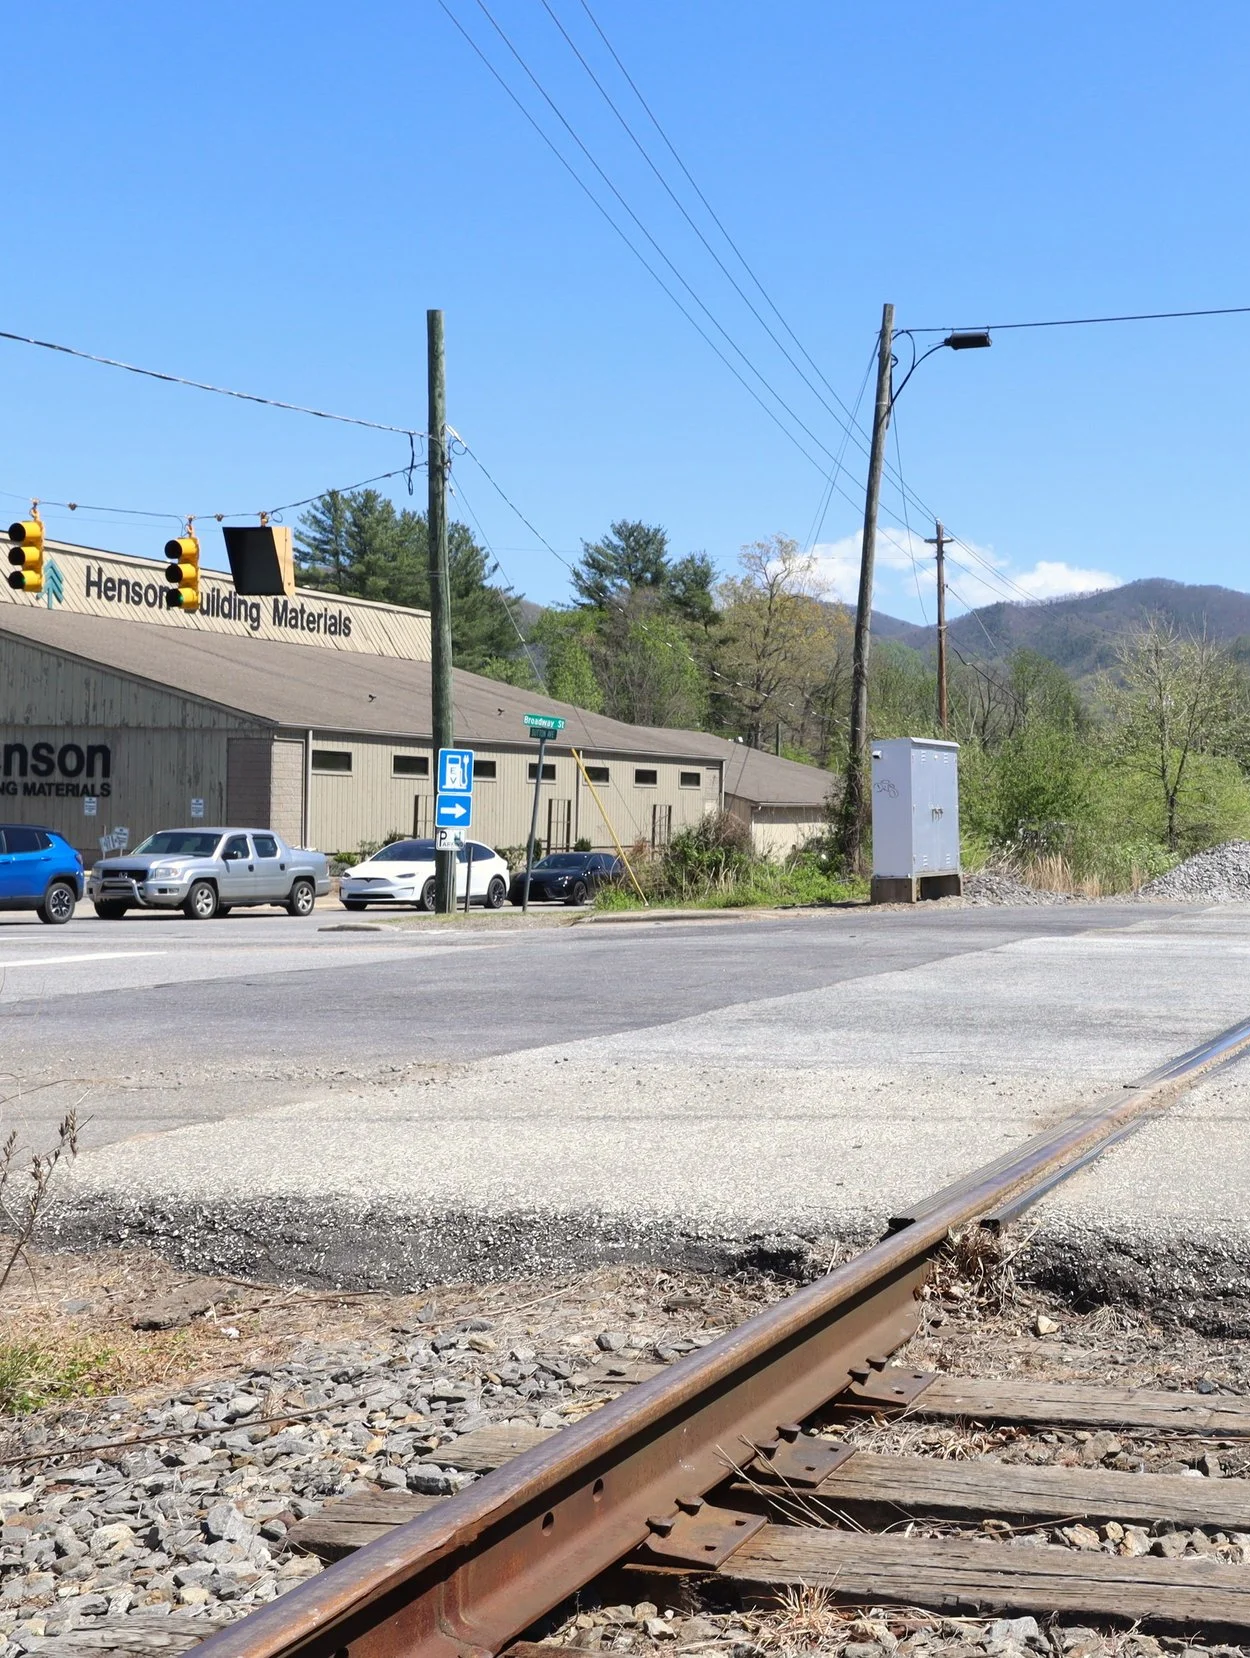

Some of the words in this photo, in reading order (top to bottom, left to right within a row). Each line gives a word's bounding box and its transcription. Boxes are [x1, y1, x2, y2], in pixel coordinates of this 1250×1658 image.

[86, 565, 171, 610] Henson
[184, 587, 261, 631] uilding
[272, 597, 351, 637] Materials
[523, 715, 555, 728] Broadway
[557, 719, 565, 729] St
[0, 742, 111, 778] nson
[23, 781, 111, 797] MATERIALS
